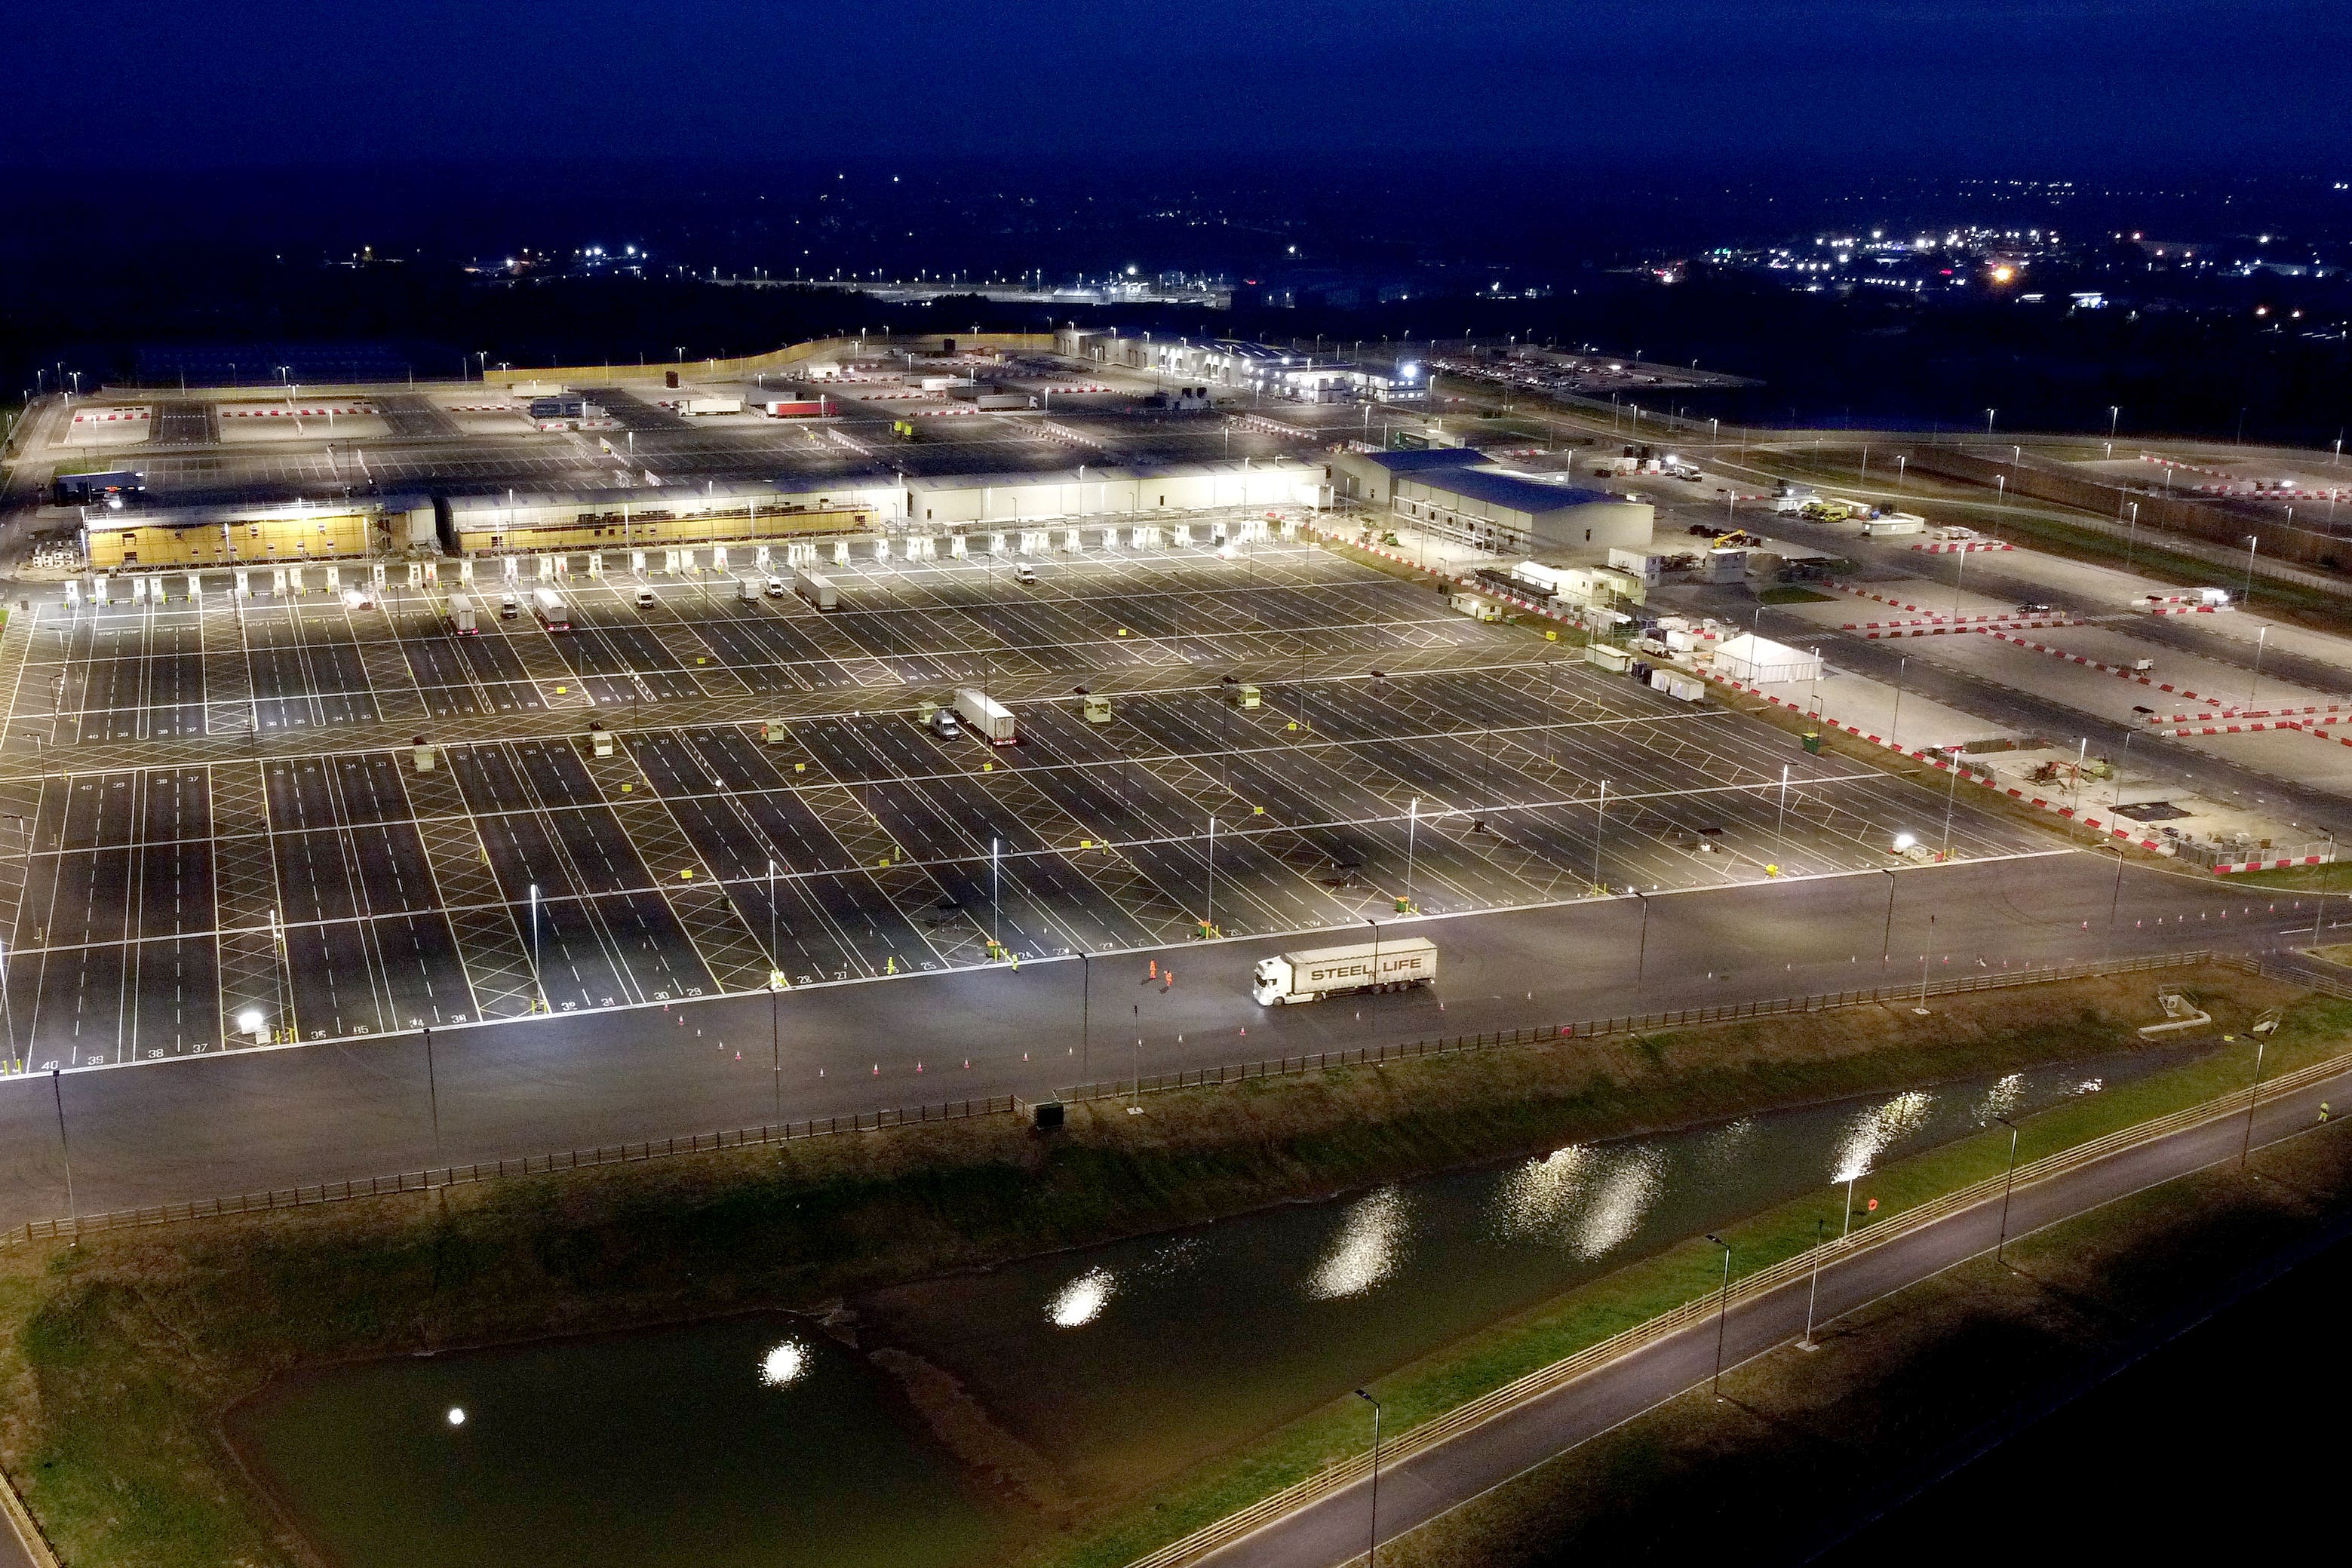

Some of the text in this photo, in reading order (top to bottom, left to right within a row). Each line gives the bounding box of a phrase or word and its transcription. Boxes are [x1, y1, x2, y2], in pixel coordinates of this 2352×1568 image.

[1018, 951, 1034, 960] 24
[920, 961, 937, 971] 25
[1311, 958, 1422, 981] STEEL LIFE
[797, 974, 813, 984] 28
[834, 971, 847, 980] 27
[653, 991, 671, 1000] 30
[686, 988, 703, 997] 29
[311, 1029, 327, 1040] 36
[148, 1048, 164, 1058] 38
[192, 1043, 208, 1053] 37
[41, 1060, 59, 1070] 40
[88, 1056, 104, 1065] 39
